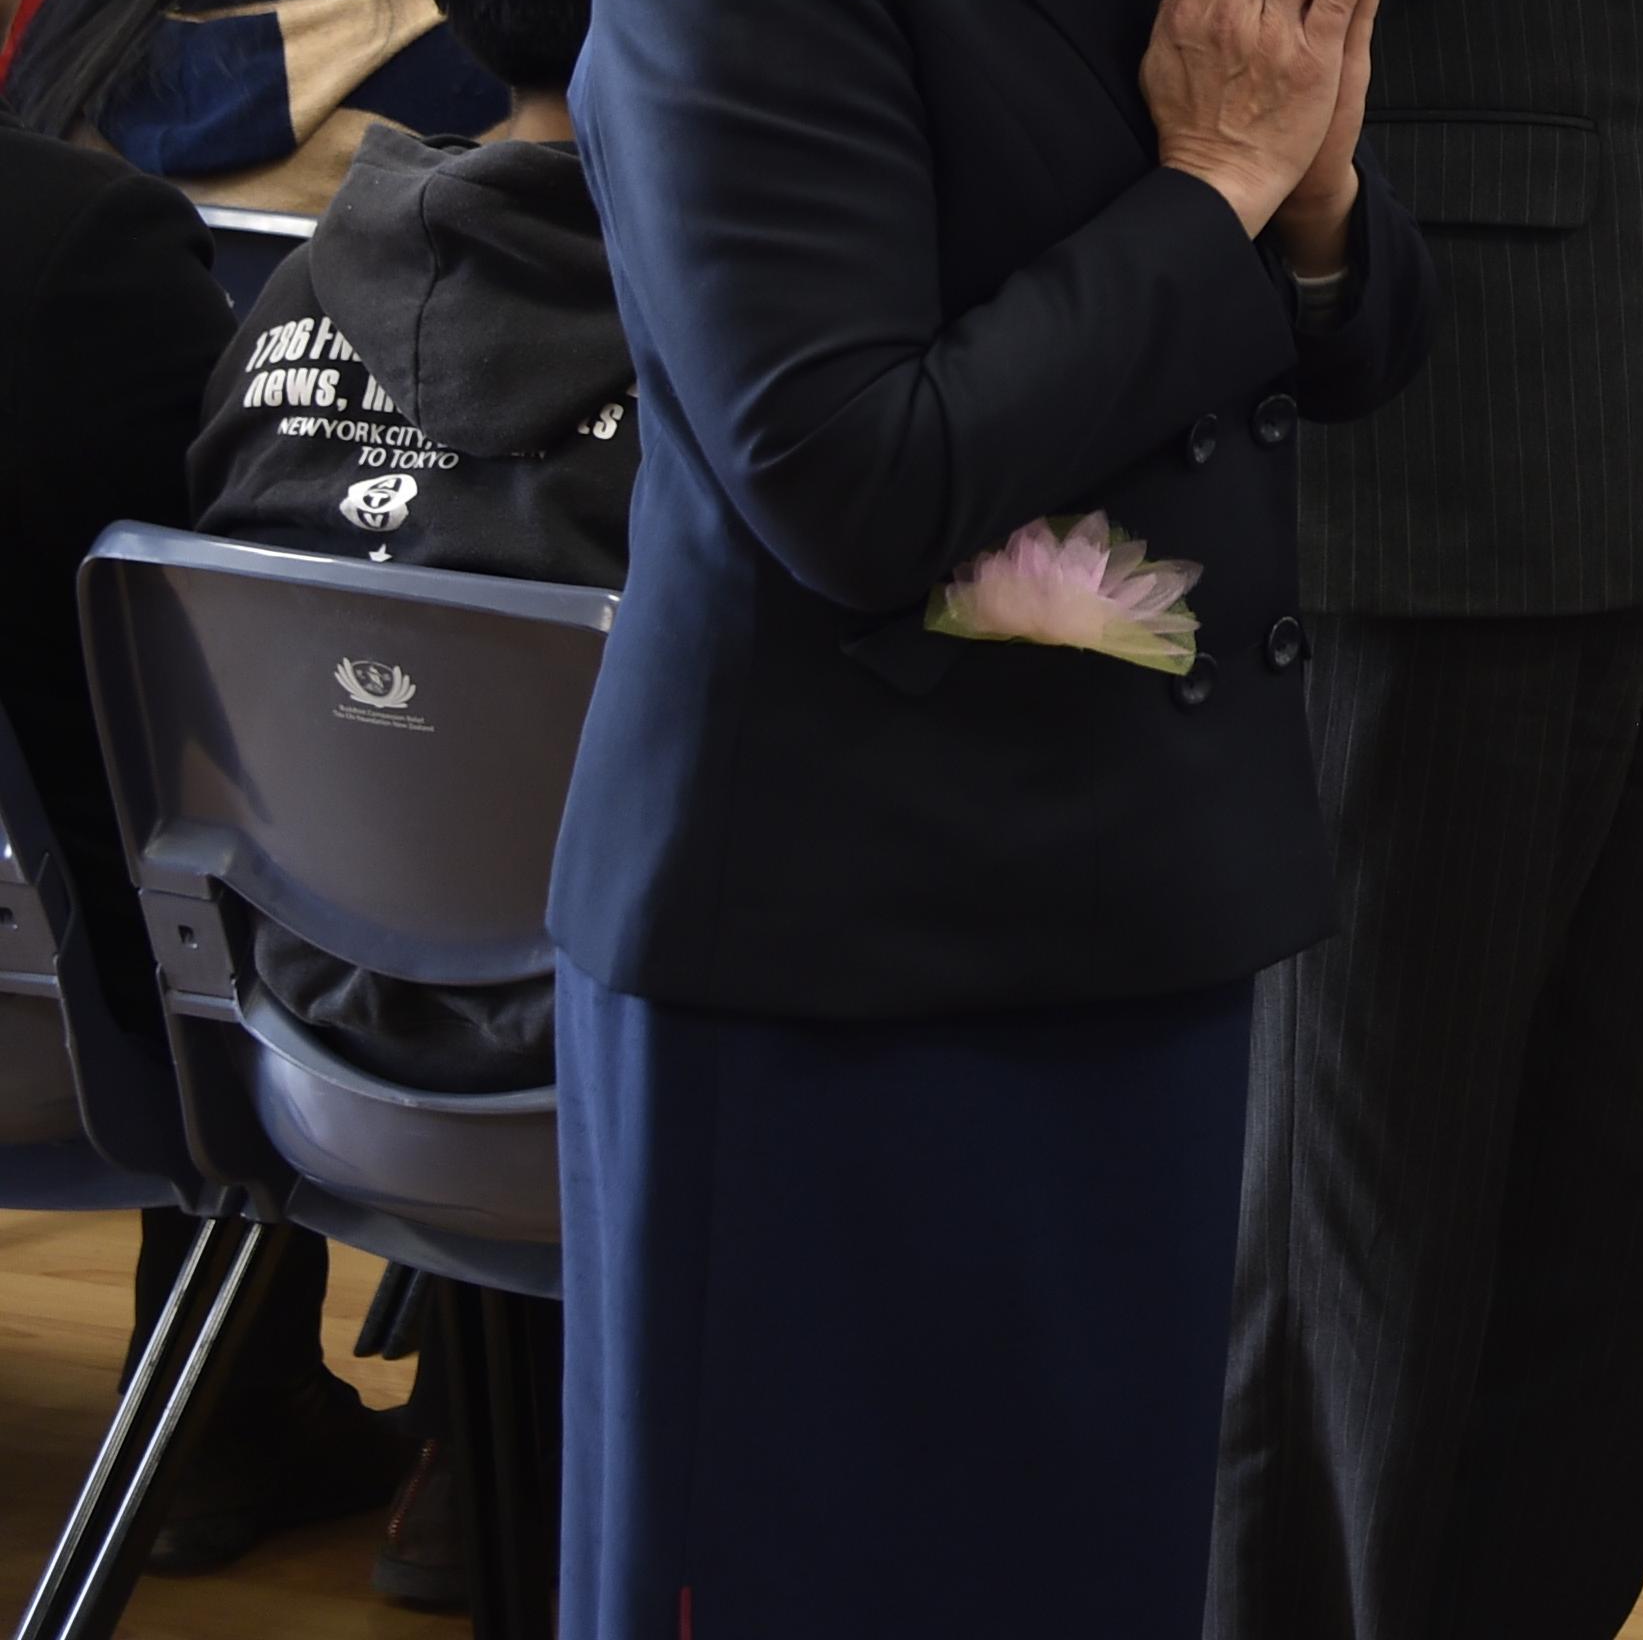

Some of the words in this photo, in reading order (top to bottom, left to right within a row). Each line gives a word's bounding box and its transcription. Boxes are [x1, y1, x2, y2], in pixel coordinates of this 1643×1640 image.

[245, 317, 315, 373] 1786
[358, 446, 387, 467] TO
[390, 448, 459, 470] TOKYO
